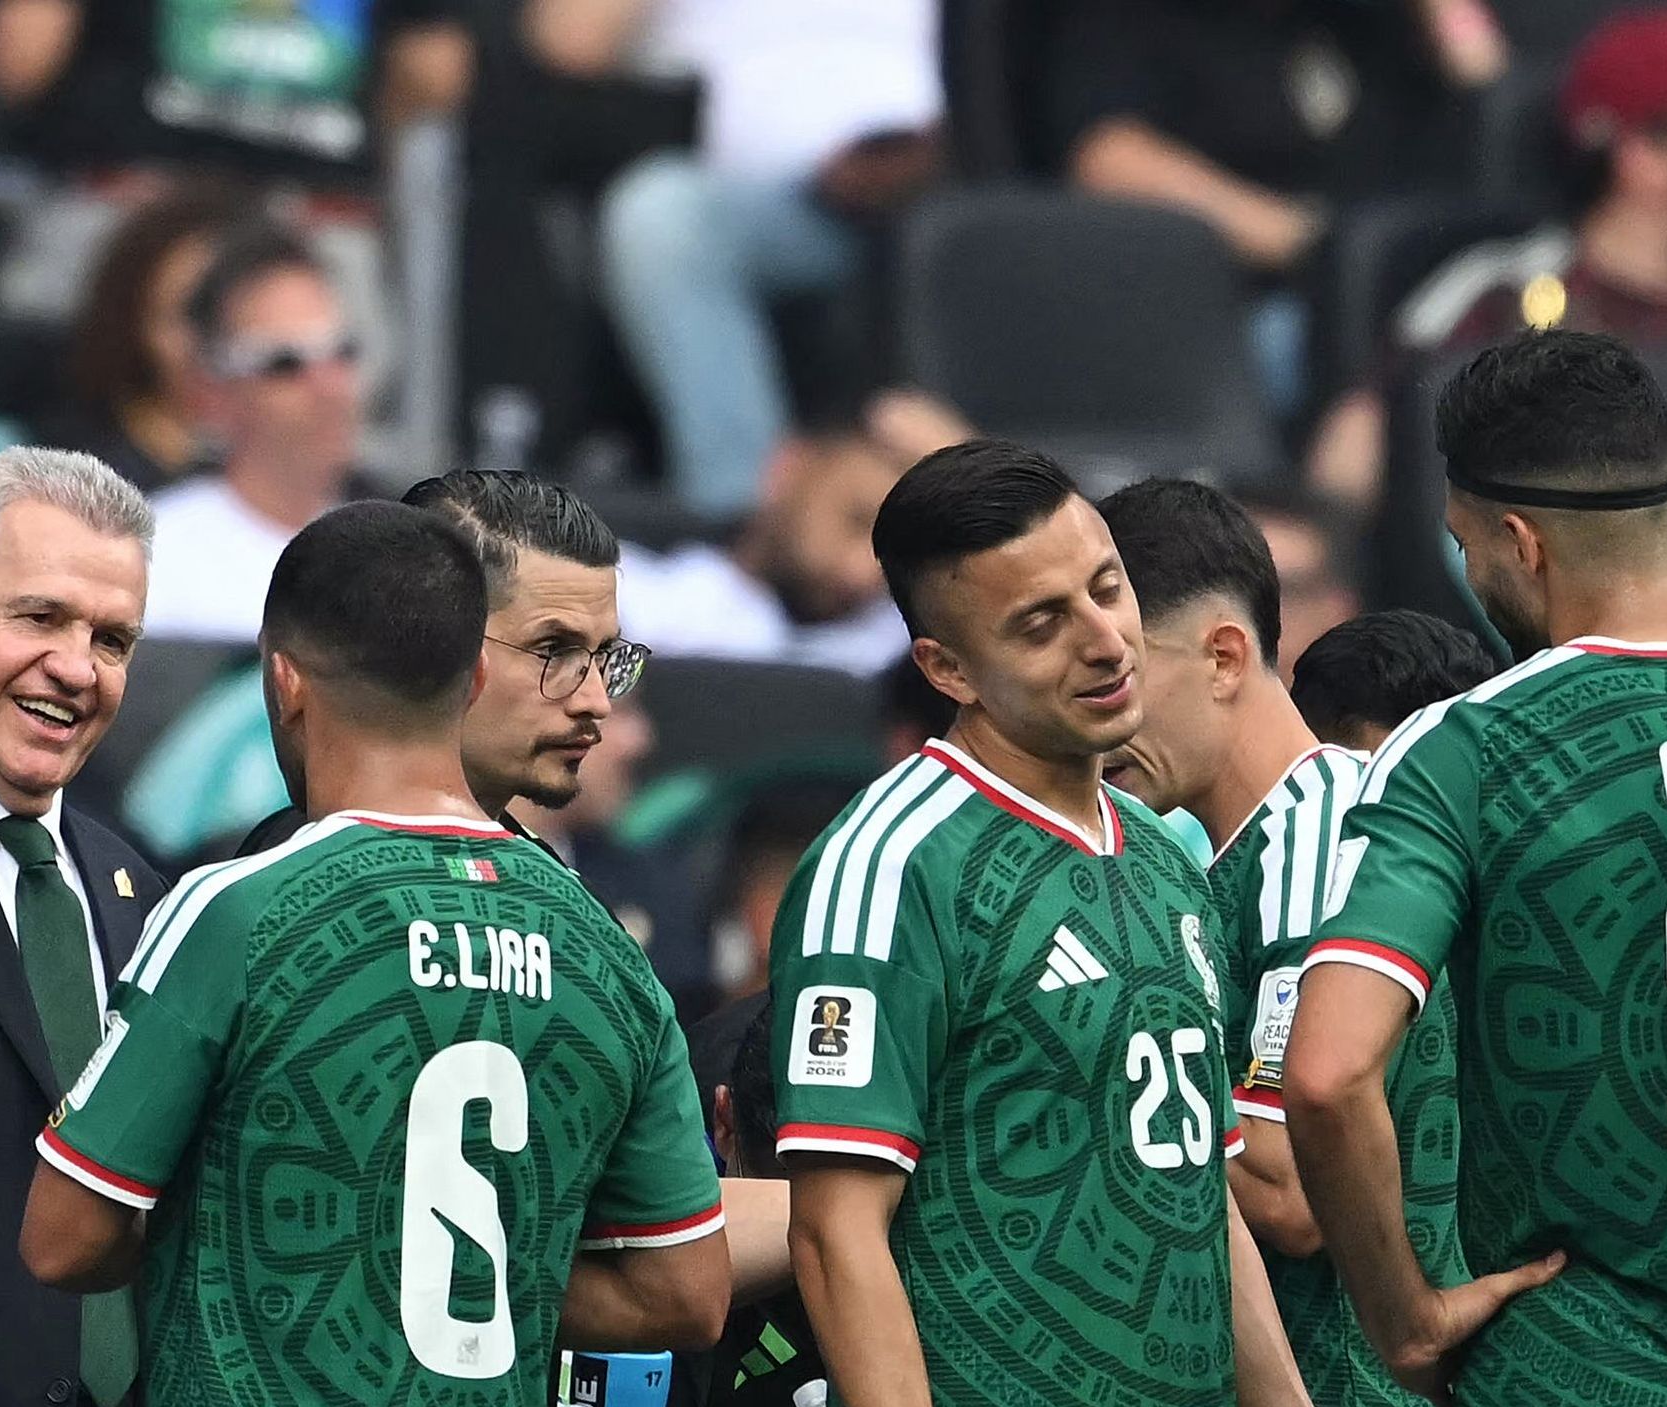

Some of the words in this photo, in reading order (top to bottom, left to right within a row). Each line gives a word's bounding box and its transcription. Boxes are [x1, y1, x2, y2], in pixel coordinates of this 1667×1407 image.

[408, 919, 553, 1002] E.LIRA
[1263, 1024, 1290, 1040] PEAC
[805, 1066, 847, 1077] 2026
[1126, 1027, 1213, 1170] 25
[400, 1039, 529, 1381] 6
[645, 1369, 664, 1389] 17
